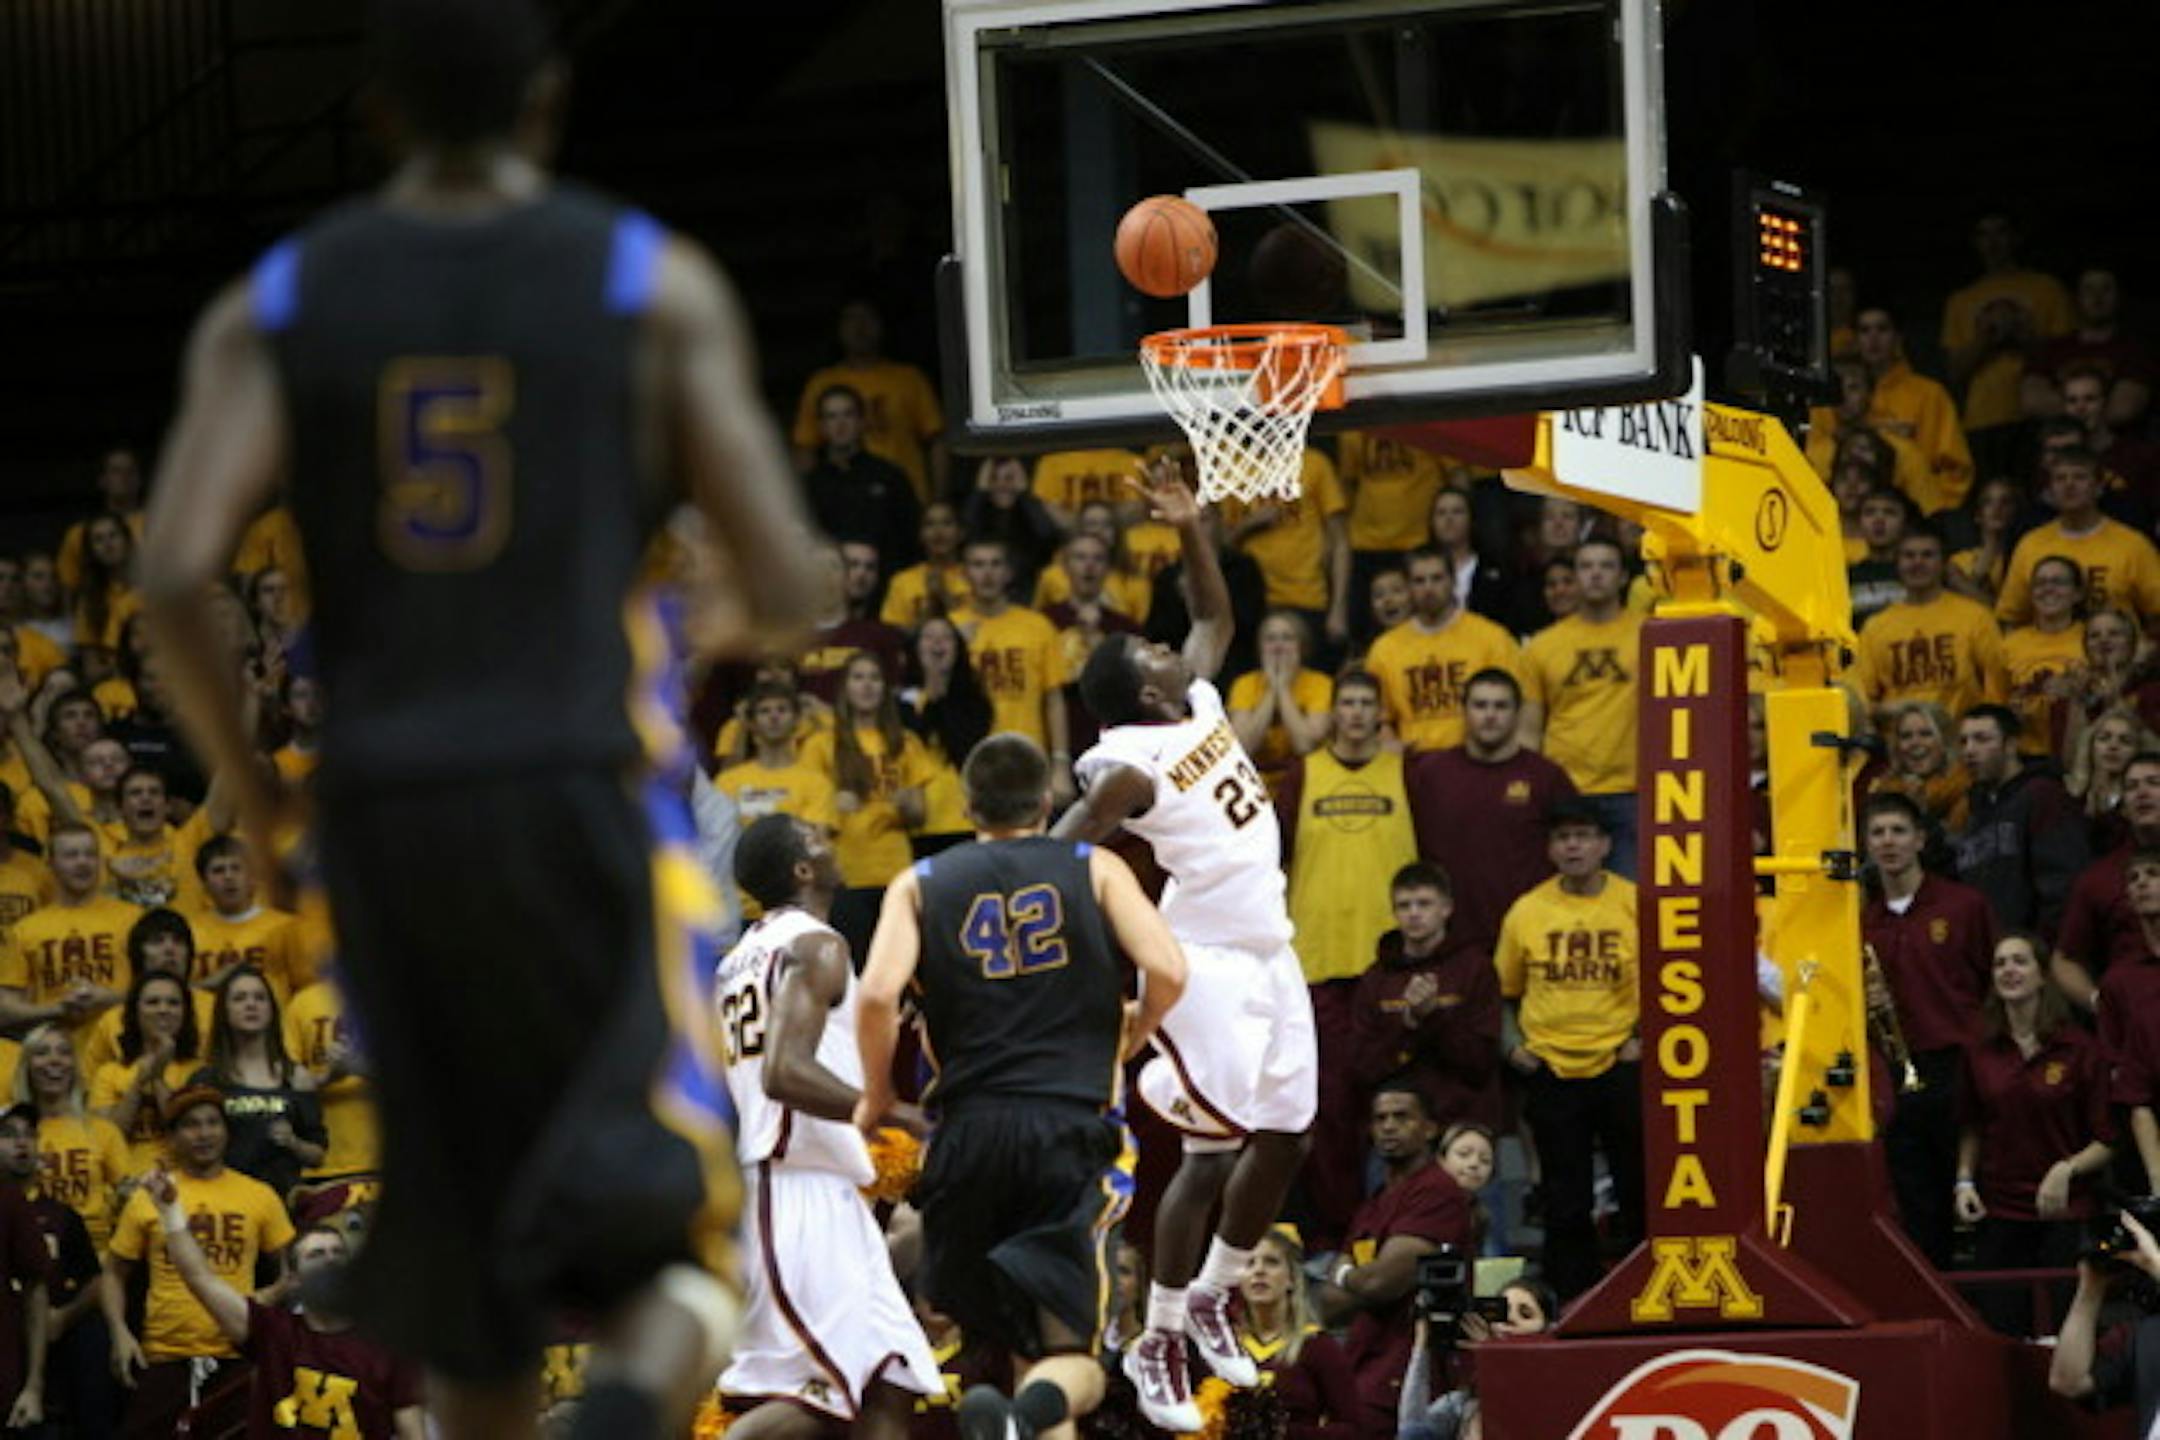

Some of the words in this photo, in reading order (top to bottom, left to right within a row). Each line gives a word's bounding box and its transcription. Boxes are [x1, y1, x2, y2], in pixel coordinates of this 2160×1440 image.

[997, 401, 1062, 422] SPALDING
[1618, 400, 1695, 459] BANK
[376, 354, 516, 575] 5
[1889, 633, 1956, 662] THE
[958, 882, 1069, 980] 42
[1653, 643, 1716, 1210] MINNESOTA
[40, 931, 114, 964] THE
[1545, 928, 1622, 960] THE
[1543, 960, 1622, 984] BARN
[38, 1176, 90, 1201] ARN
[1630, 1235, 1764, 1322] M
